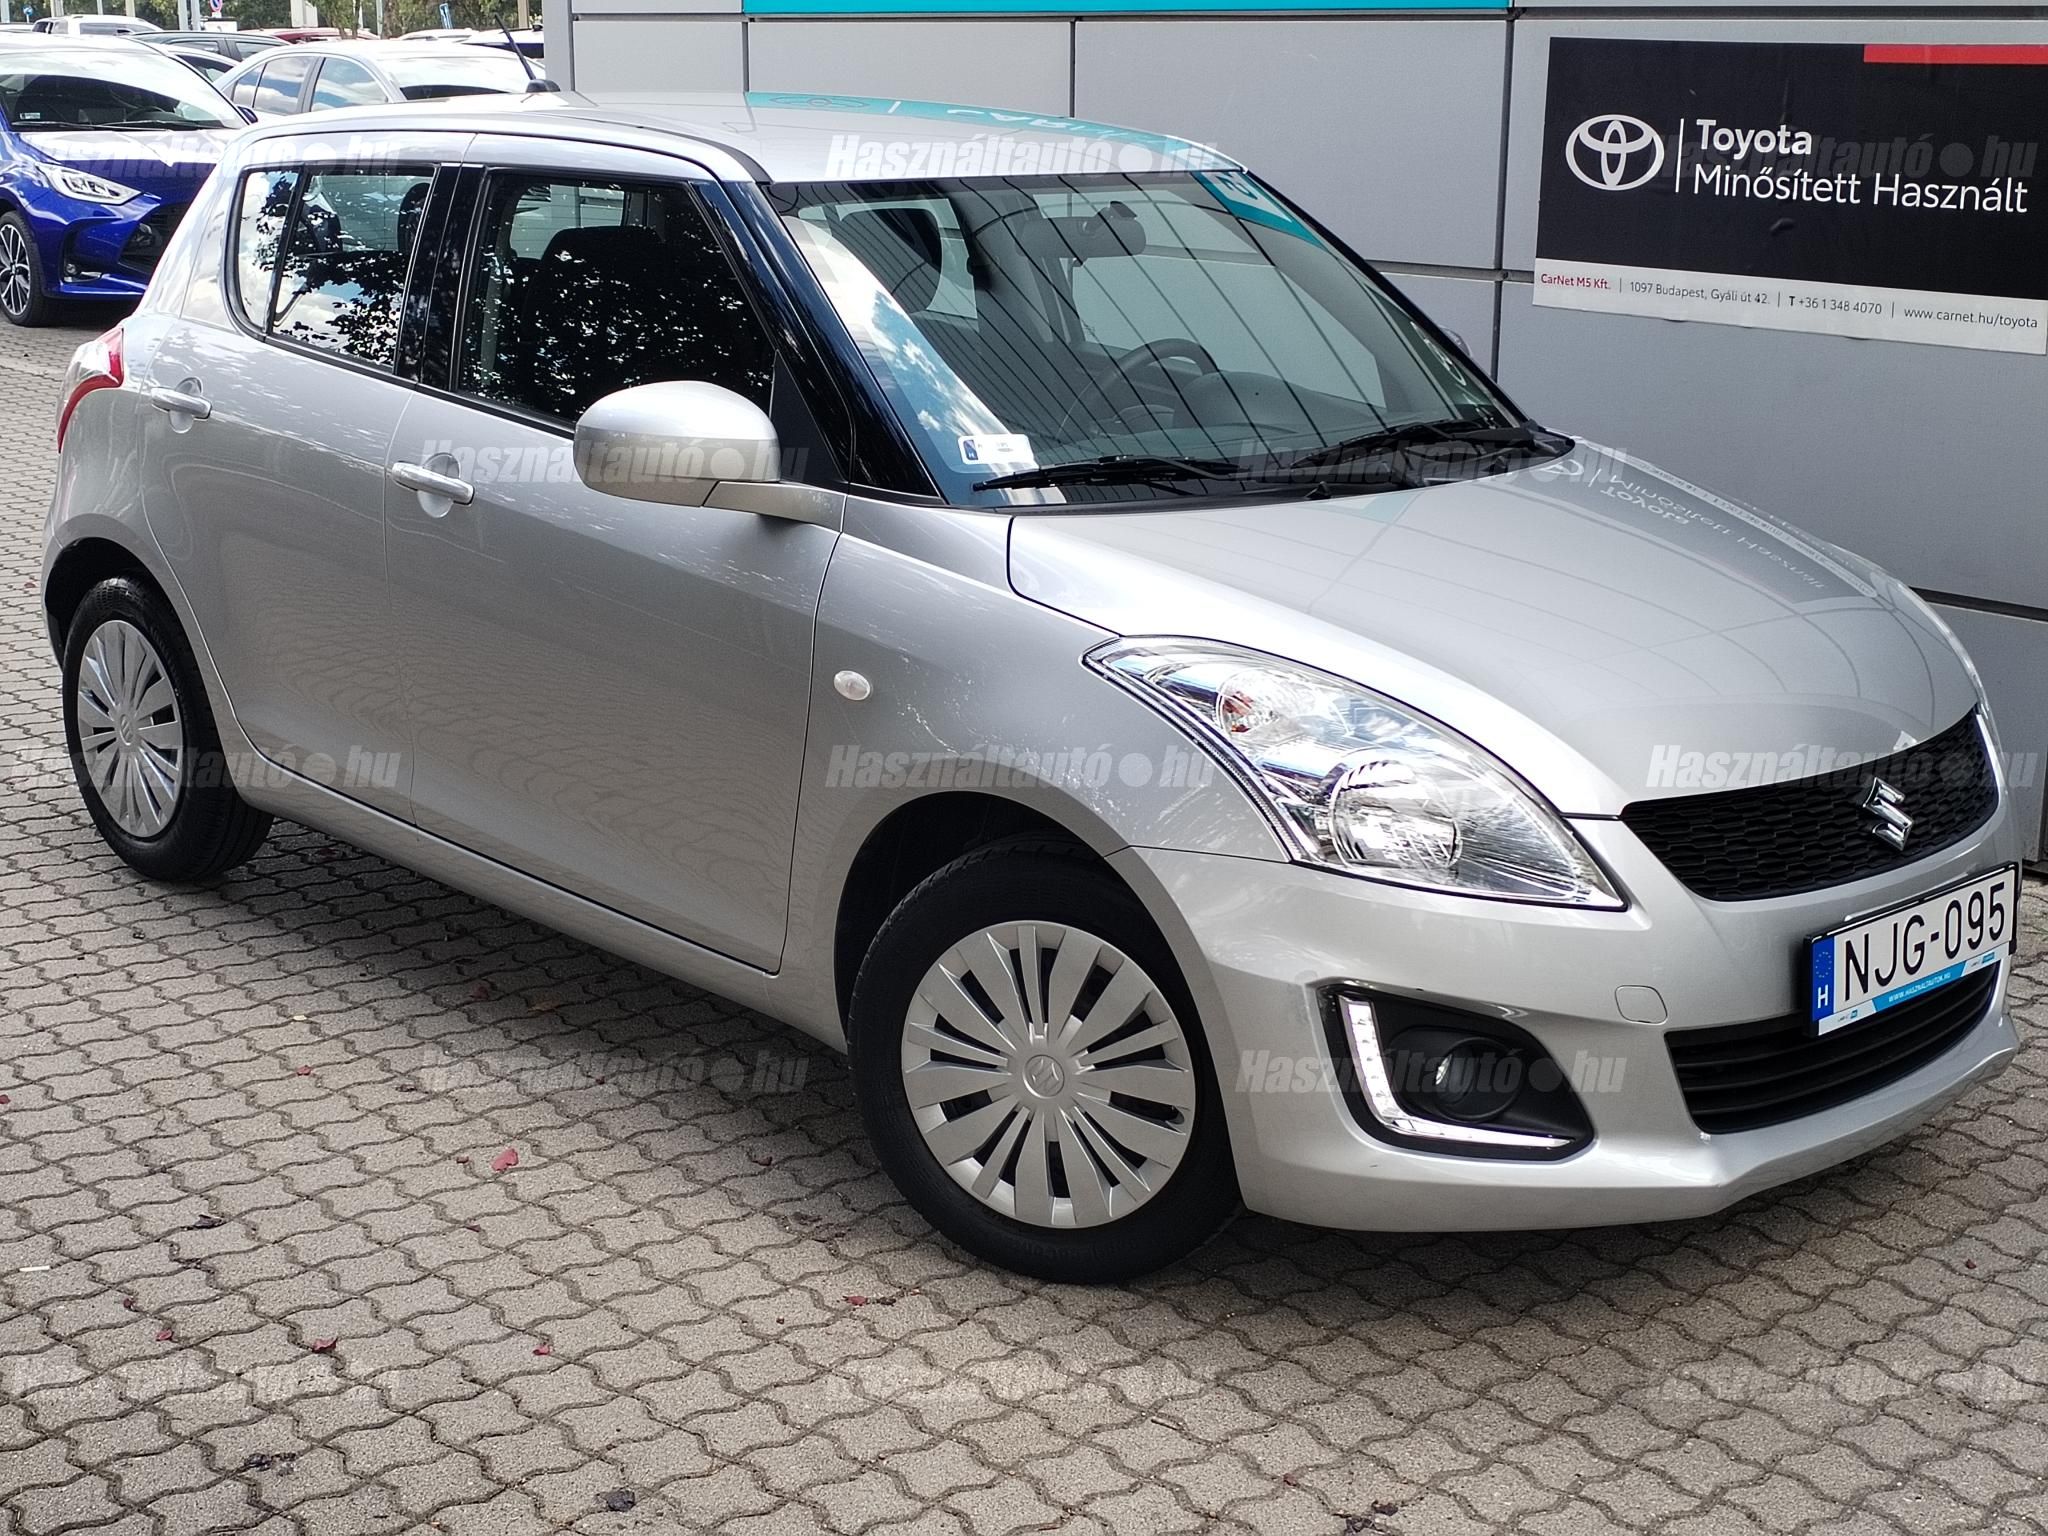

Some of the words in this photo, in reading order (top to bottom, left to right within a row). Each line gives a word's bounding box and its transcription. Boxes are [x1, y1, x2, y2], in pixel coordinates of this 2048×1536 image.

[1696, 119, 1812, 160] Toyota
[1693, 164, 1861, 204] Minősített
[1874, 172, 2028, 213] Használt
[1540, 274, 1574, 287] CarNet
[1576, 277, 1592, 288] M5
[1593, 278, 1611, 290] Kft.
[1630, 281, 1653, 293] 1097
[1656, 284, 1708, 300] Budapest,
[1710, 288, 1738, 303] Gyáli
[1740, 291, 1751, 303] út
[1788, 296, 1796, 307] T
[1798, 297, 1819, 309] +36
[1821, 299, 1827, 310] 1
[1830, 300, 1850, 312] 348
[1853, 302, 1882, 315] 4070
[1904, 307, 2038, 329] www.carnet.hu/toyota
[1844, 881, 2005, 1002] NJG-095
[1817, 984, 1829, 1009] H
